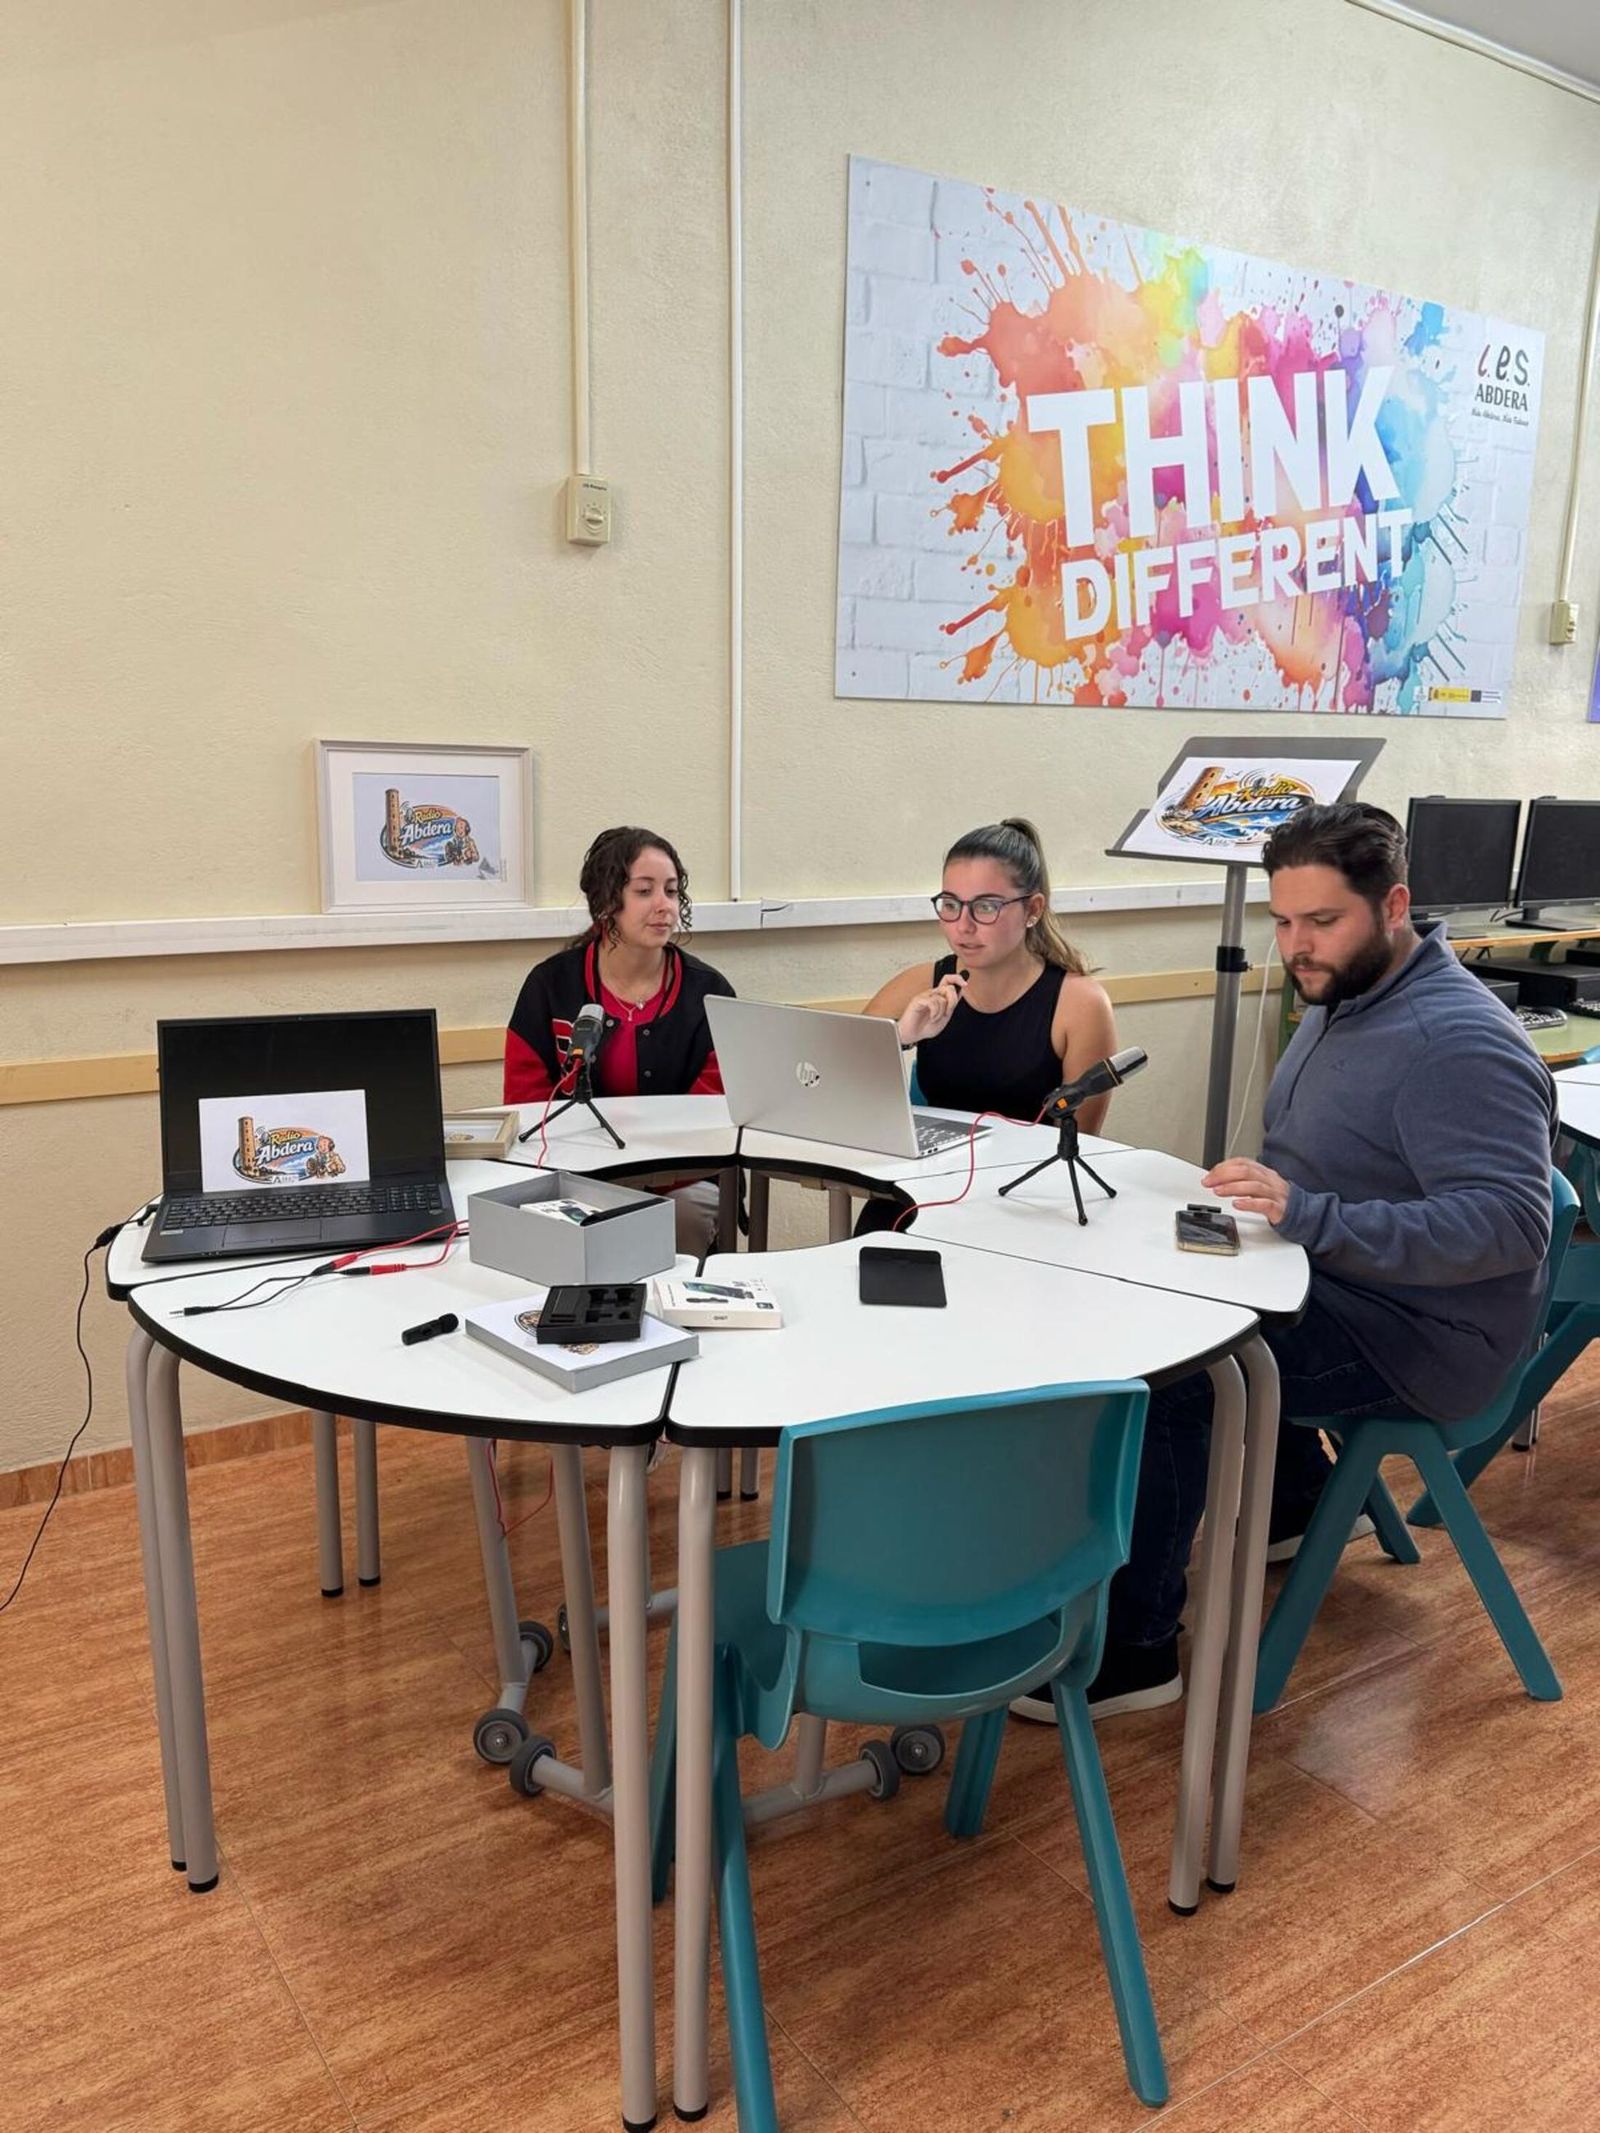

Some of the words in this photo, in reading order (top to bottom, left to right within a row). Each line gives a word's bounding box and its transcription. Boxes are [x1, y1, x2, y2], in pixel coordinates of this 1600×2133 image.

[1475, 383, 1528, 411] ABDERA
[1026, 365, 1401, 548] THINK
[1060, 508, 1415, 640] DIFFERENT
[414, 810, 441, 824] Radio
[1193, 795, 1303, 820] Abdera
[399, 822, 452, 846] Abdera
[796, 1061, 821, 1089] hp
[270, 1131, 302, 1145] Radio
[255, 1141, 313, 1166] Abdera
